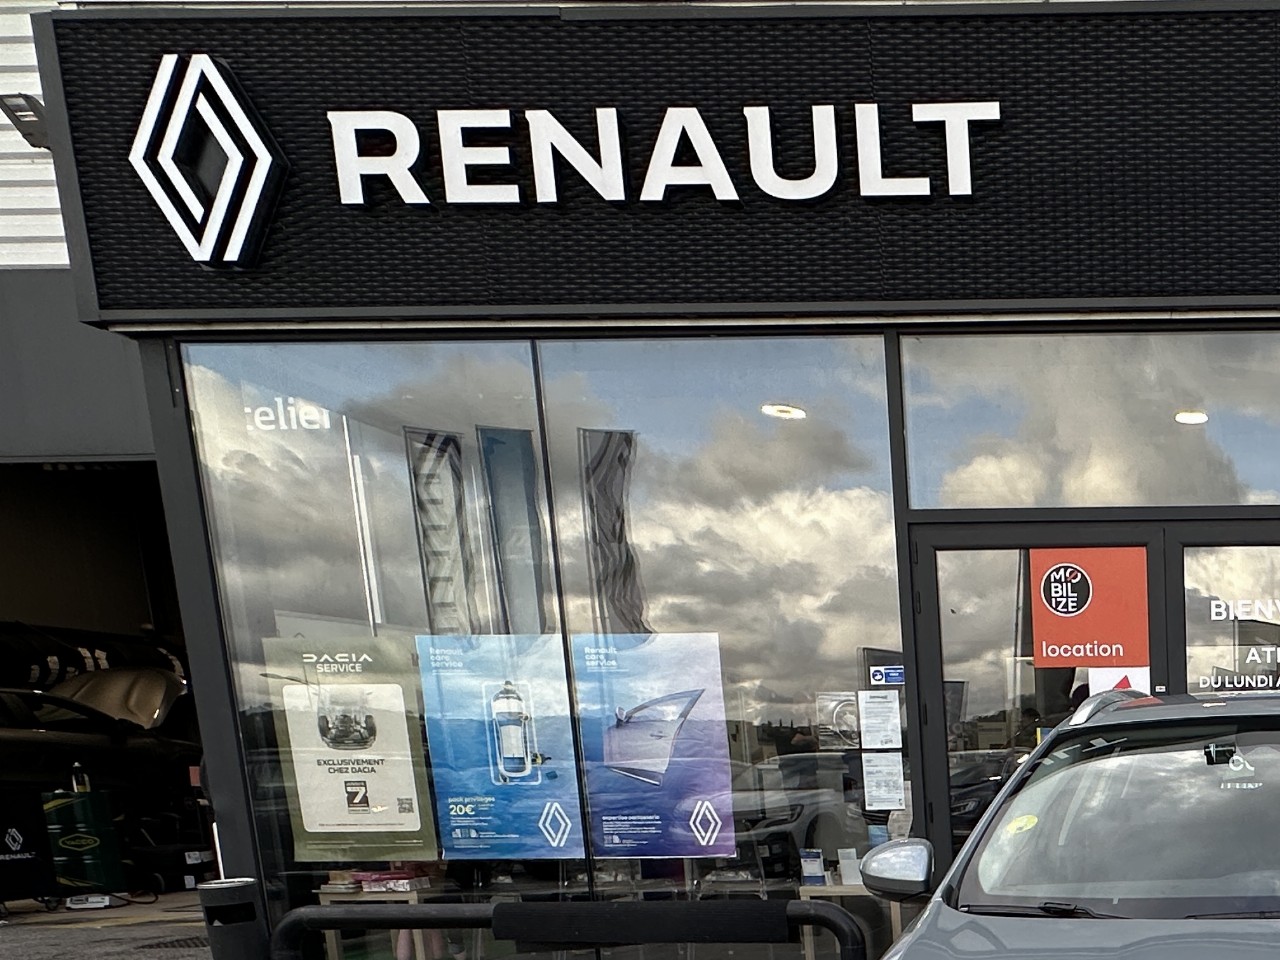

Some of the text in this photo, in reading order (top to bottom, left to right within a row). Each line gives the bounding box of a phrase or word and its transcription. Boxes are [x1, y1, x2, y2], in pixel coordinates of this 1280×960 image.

[327, 101, 1000, 205] RENAULT
[1042, 641, 1123, 657] location
[316, 663, 363, 673] SERVICE
[1199, 676, 1222, 688] DU
[1225, 675, 1273, 688] LUNDI
[316, 758, 385, 766] EXCLUSIVEMENT
